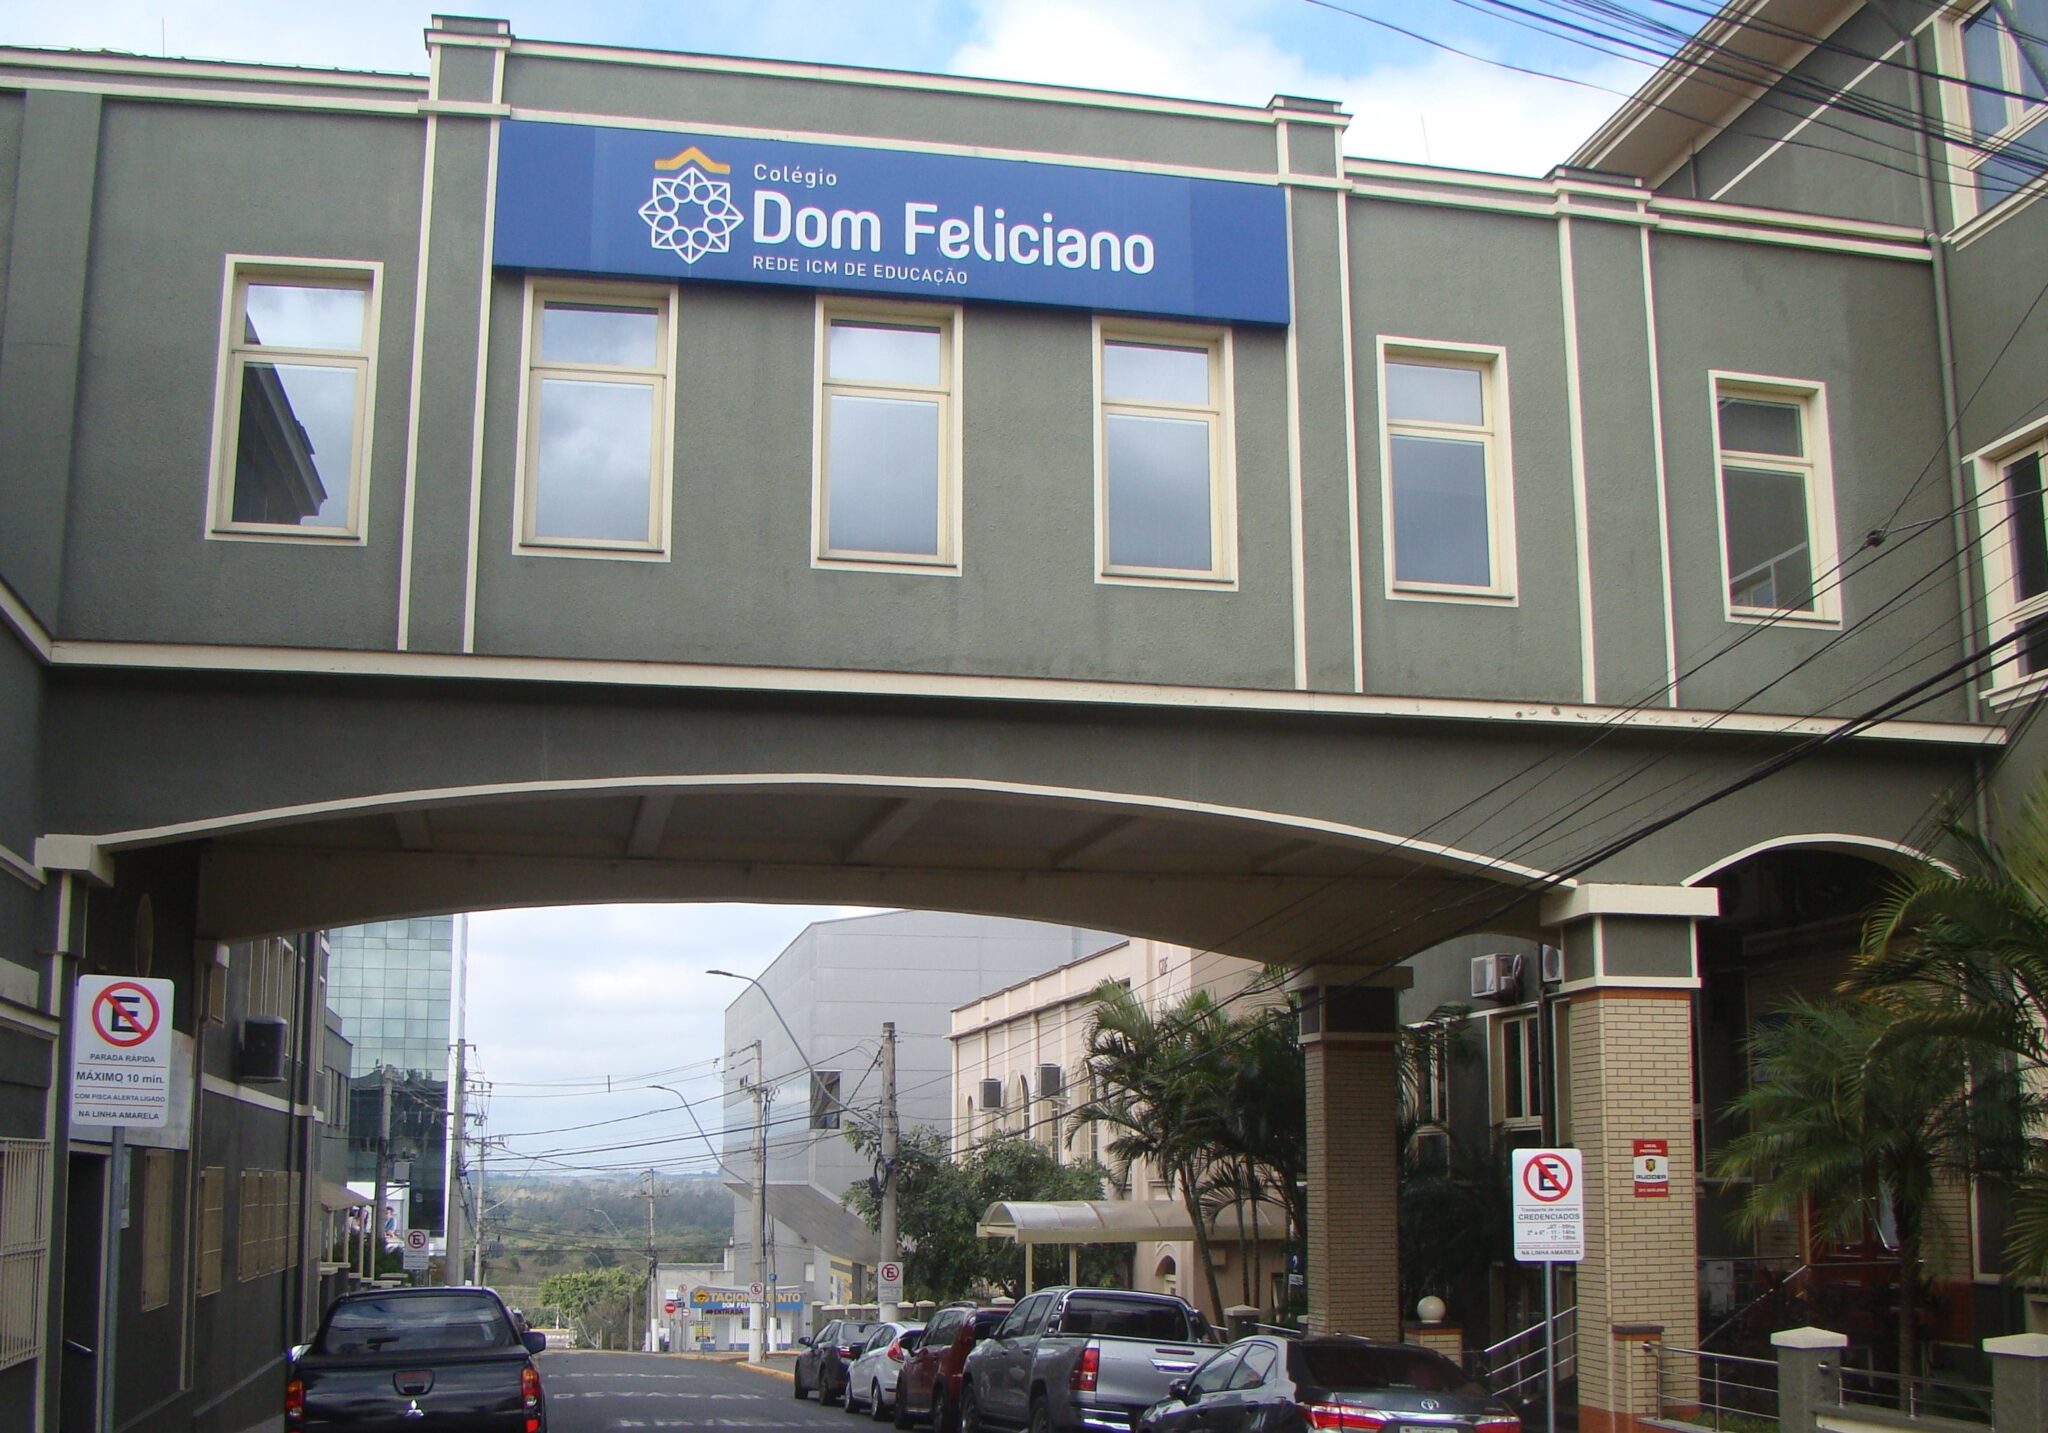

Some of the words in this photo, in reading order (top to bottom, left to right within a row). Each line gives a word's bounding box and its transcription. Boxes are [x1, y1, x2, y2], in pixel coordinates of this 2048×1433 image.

[754, 164, 837, 189] Colégio
[753, 190, 881, 253] Dom
[904, 202, 1155, 275] Feliciano
[753, 256, 799, 272] REDE
[806, 260, 837, 275] ICM
[844, 262, 867, 277] DE
[873, 264, 968, 286] EDUCAÇÃO
[90, 1053, 124, 1061] PARADA
[76, 1069, 124, 1082] MÁXIMO
[127, 1073, 140, 1083] 10
[78, 1110, 91, 1118] NA
[92, 1111, 118, 1119] LINHA
[118, 1112, 160, 1121] AMARELA
